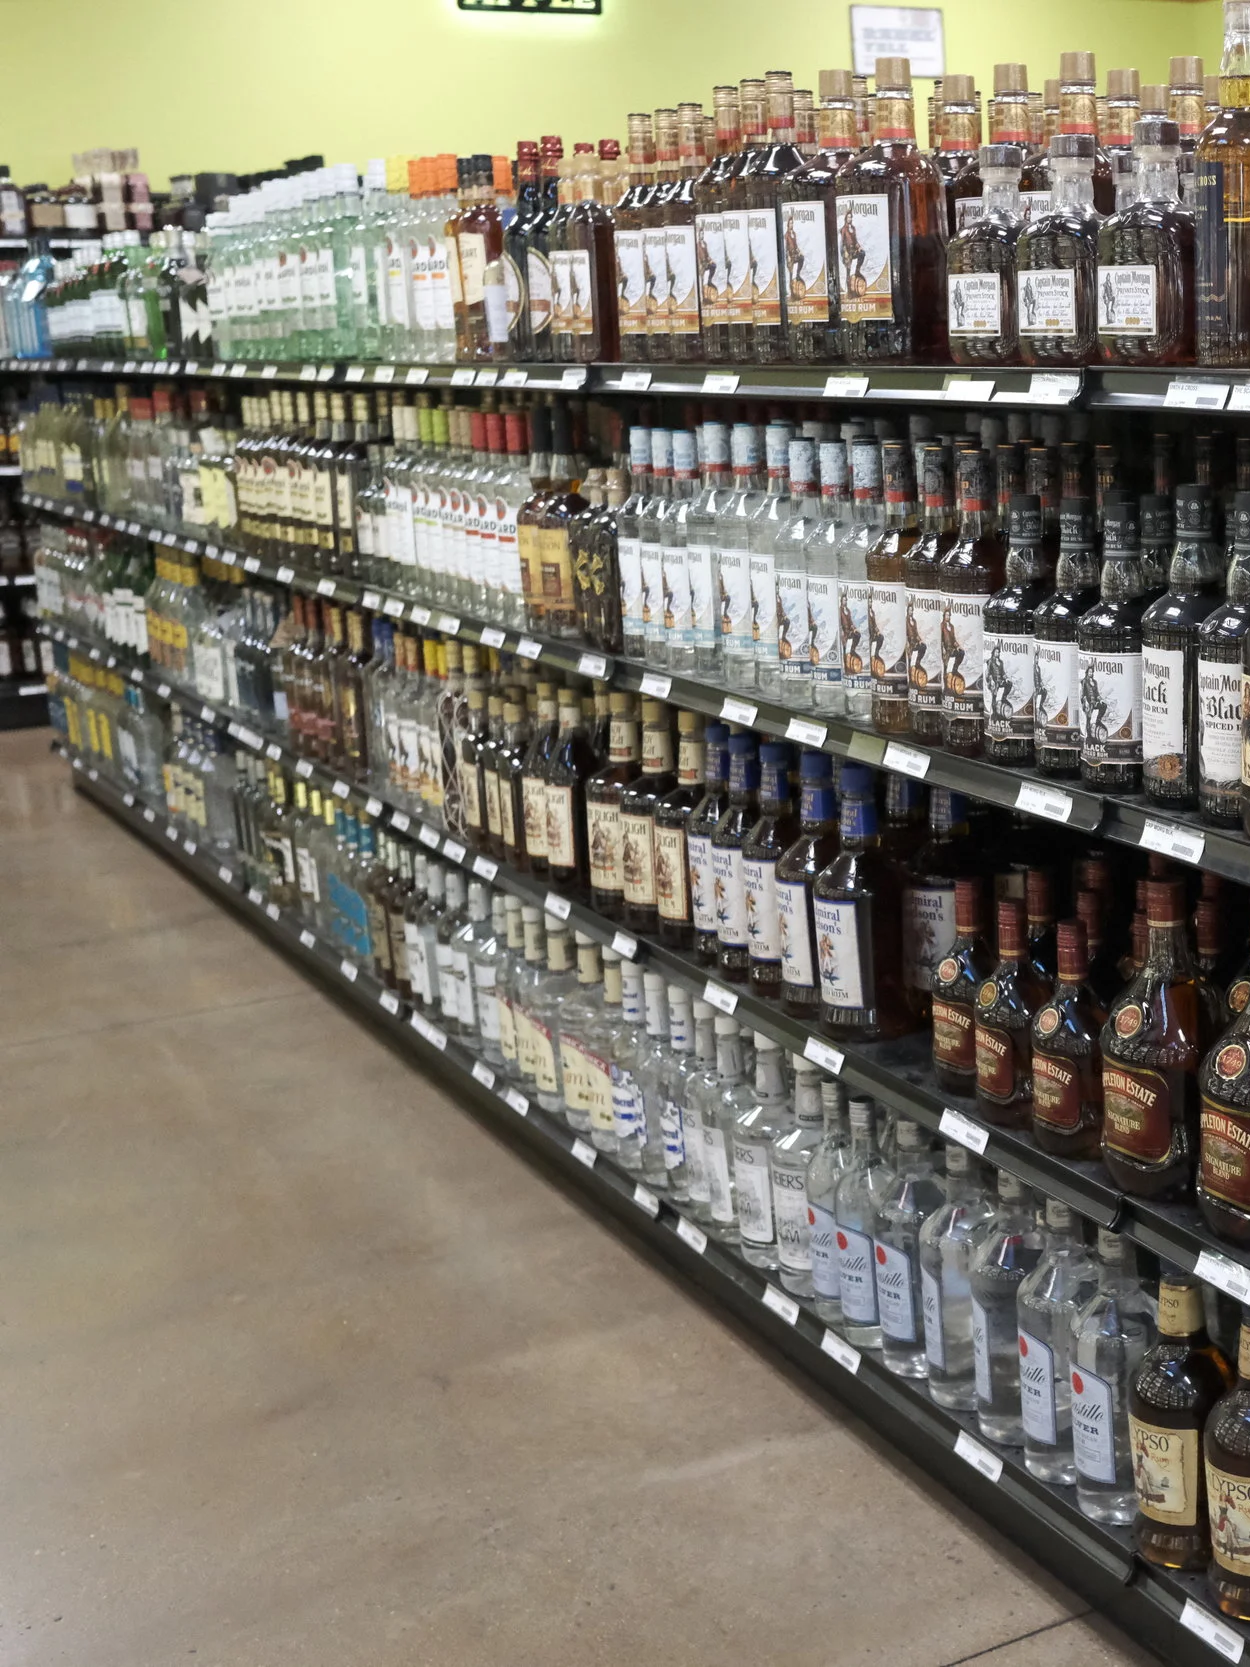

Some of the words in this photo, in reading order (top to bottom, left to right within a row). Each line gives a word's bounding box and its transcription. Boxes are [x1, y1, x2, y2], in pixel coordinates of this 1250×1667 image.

[790, 205, 816, 221] Morgan
[849, 200, 878, 216] Morgan
[908, 595, 941, 612] Morgan
[948, 600, 980, 617] Morgan
[999, 640, 1028, 655] Morgan
[1091, 659, 1123, 675] Morgan
[955, 703, 974, 711] RUM
[1152, 706, 1168, 715] RUM
[1207, 696, 1242, 720] Blac
[989, 719, 1011, 728] BLACK
[1206, 720, 1235, 730] SPICED
[949, 1010, 971, 1029] ESTATE
[1120, 1016, 1138, 1028] 1749
[1221, 1054, 1241, 1068] 1749
[1047, 1060, 1072, 1086] ESTATE
[1126, 1082, 1157, 1107] ESTATE
[1107, 1110, 1140, 1130] SIGNATURE
[1114, 1122, 1130, 1134] BLEND
[1204, 1152, 1242, 1177] SIGNATURE
[1212, 1165, 1230, 1180] BLEND
